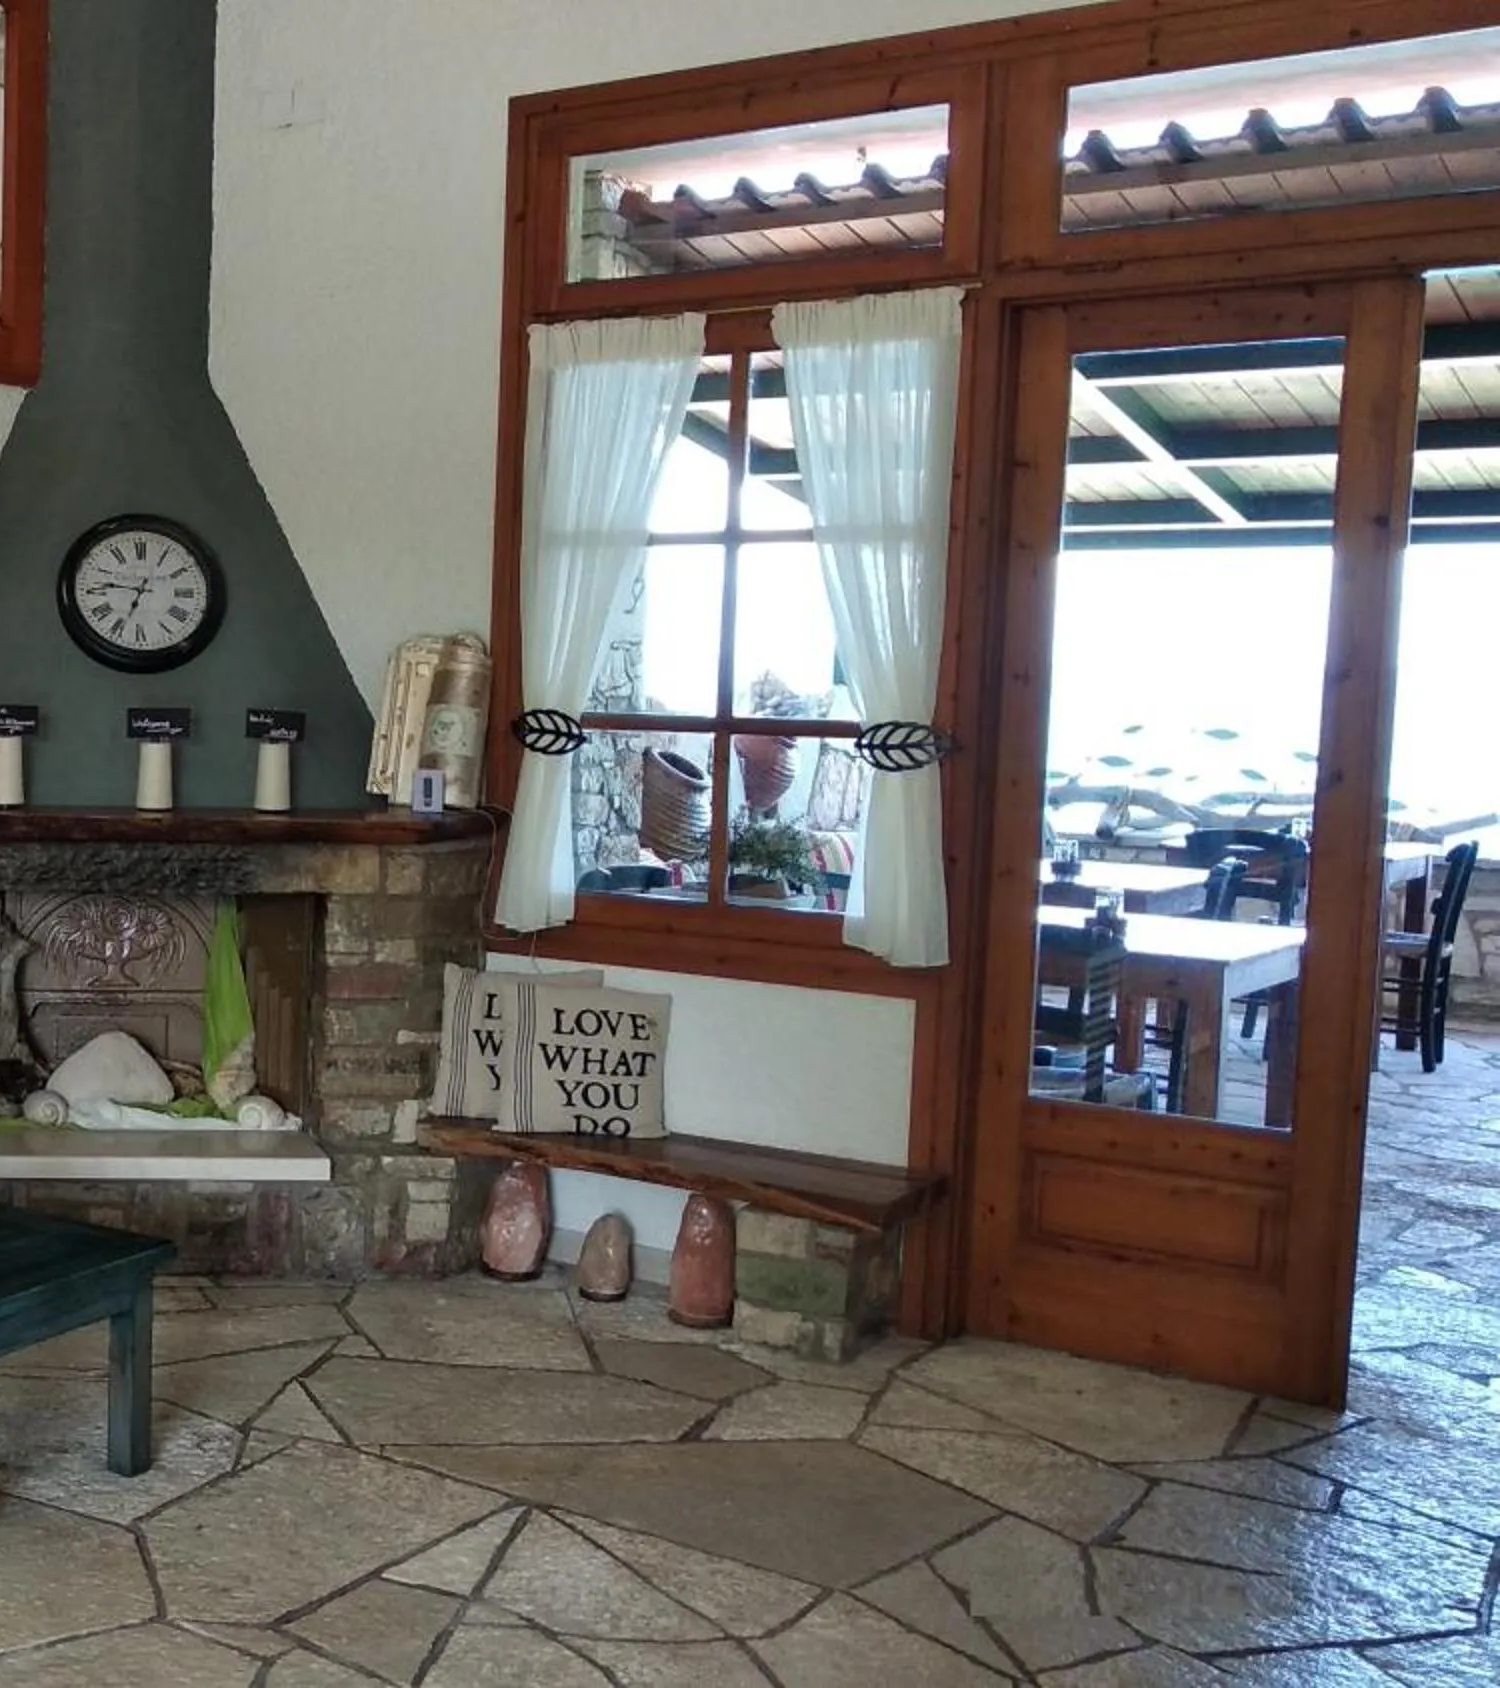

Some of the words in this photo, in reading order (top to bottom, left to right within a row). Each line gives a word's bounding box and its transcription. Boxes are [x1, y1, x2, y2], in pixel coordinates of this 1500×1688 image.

[553, 1007, 651, 1041] LOVE
[538, 1043, 656, 1077] WHAT
[555, 1079, 640, 1111] YOU
[573, 1115, 631, 1138] DO
